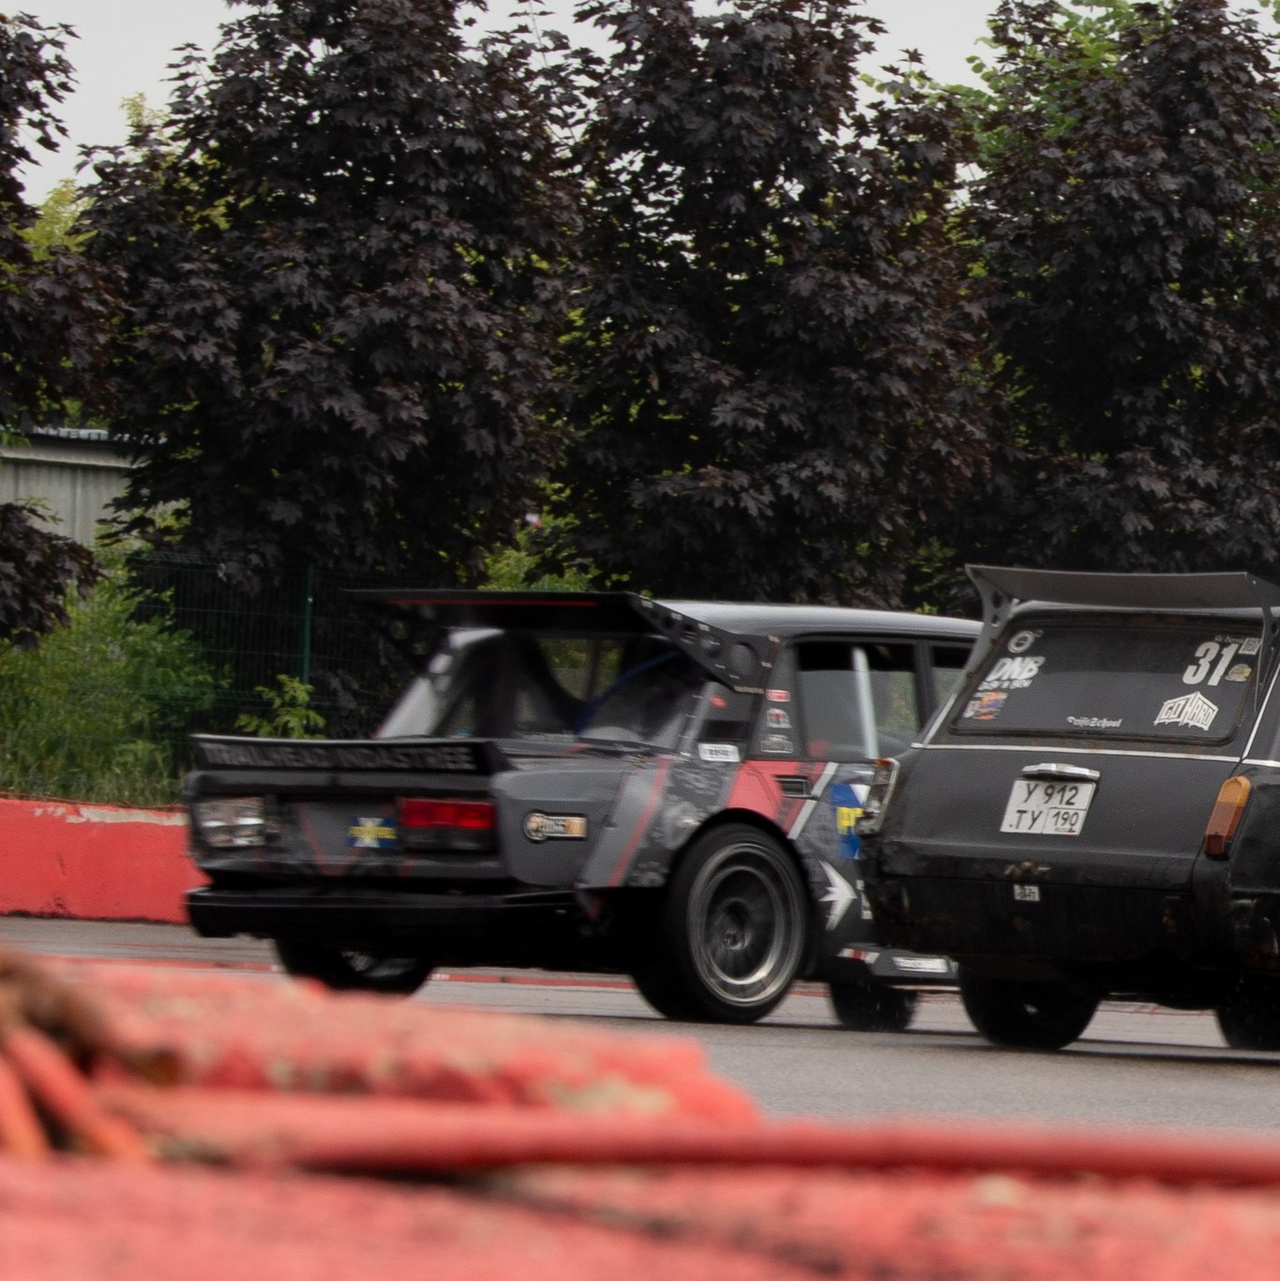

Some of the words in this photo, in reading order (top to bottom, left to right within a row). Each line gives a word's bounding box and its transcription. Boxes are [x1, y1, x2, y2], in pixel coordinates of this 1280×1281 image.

[1183, 641, 1239, 686] 31
[1044, 784, 1079, 806] 912
[1052, 810, 1079, 827] 190
